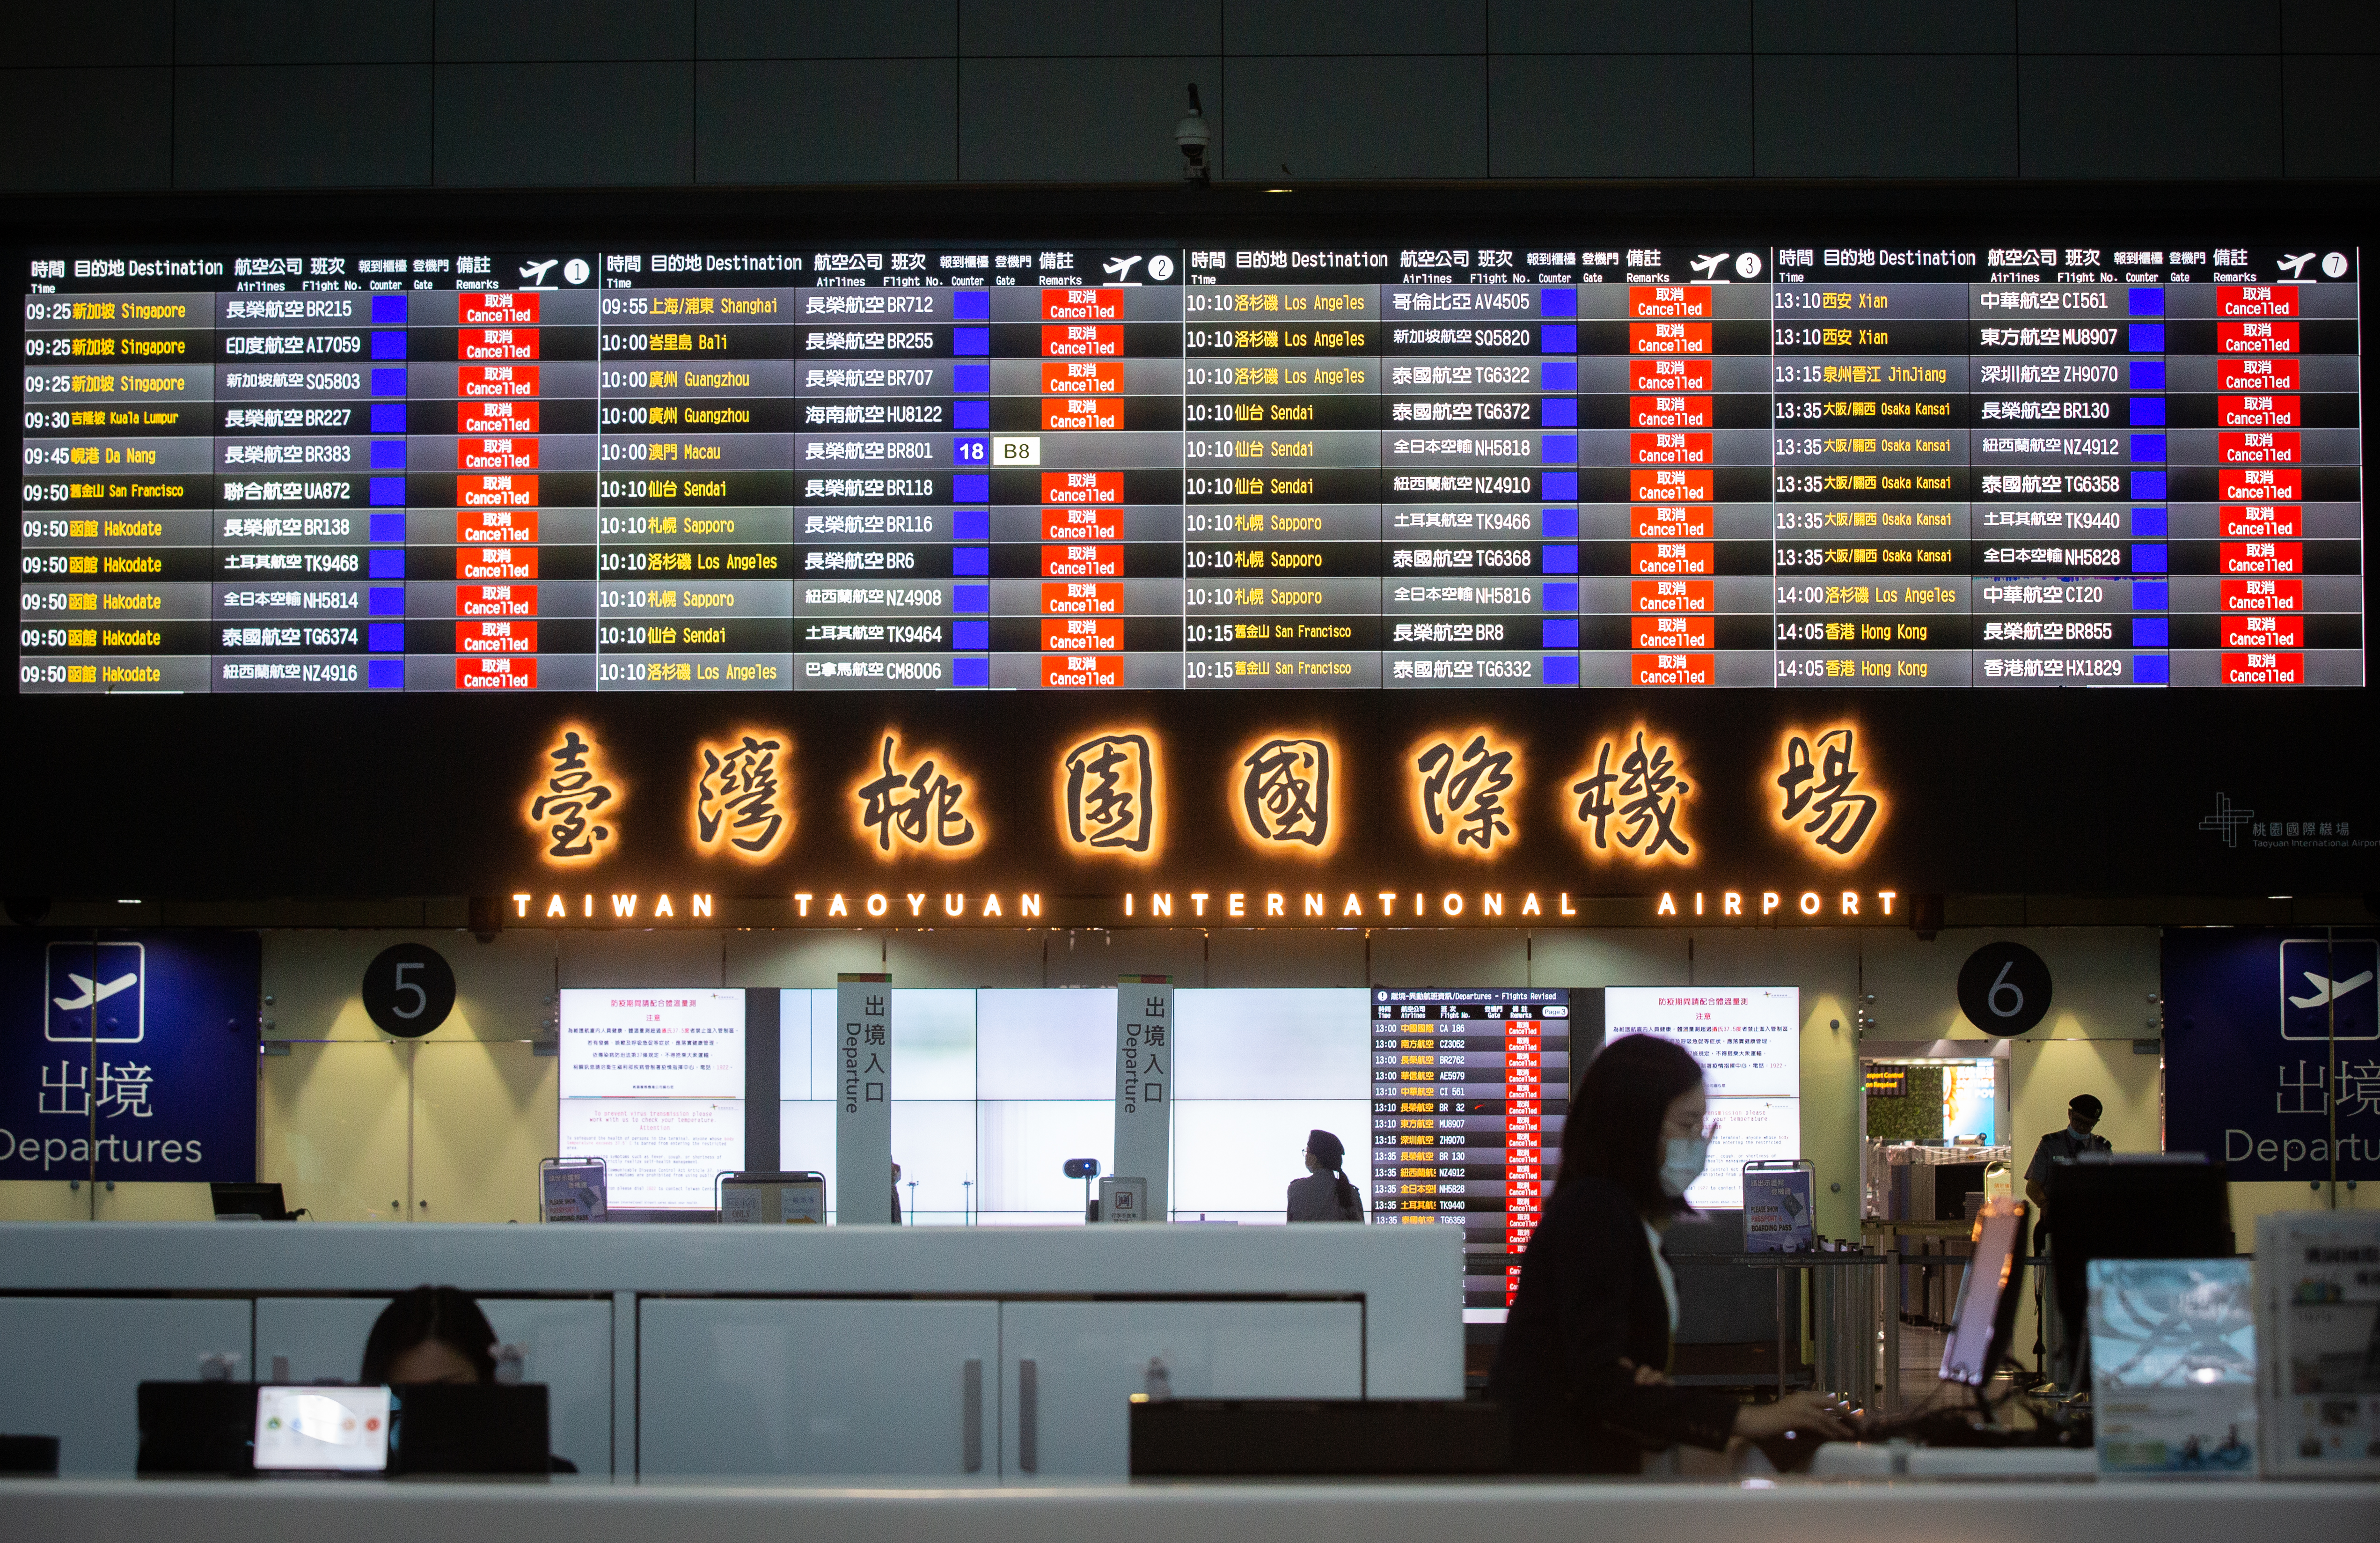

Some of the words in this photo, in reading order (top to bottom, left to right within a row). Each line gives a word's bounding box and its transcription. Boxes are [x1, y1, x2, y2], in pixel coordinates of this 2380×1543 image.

[31, 260, 65, 279] 時間
[75, 259, 125, 277] 目的地
[129, 259, 223, 276] Destination
[234, 257, 302, 276] 航空公司
[310, 257, 345, 275] 班次
[412, 259, 449, 272] 登機門
[456, 256, 491, 274] 備註
[574, 263, 581, 280] 1
[31, 284, 56, 294] Time
[236, 281, 286, 292] Airlines
[302, 280, 339, 292] Flight
[344, 280, 362, 291] No.
[369, 280, 402, 291] Counter
[413, 279, 433, 290] Gate
[456, 279, 499, 290] Remarks
[1655, 287, 1684, 301] 取消
[484, 293, 513, 308] 取消
[1068, 289, 1096, 304] 取消
[1187, 294, 1233, 311] 10:10
[1234, 294, 1278, 311] 洛杉磯
[1285, 294, 1307, 310] Los
[1314, 294, 1364, 311] Angeles
[1392, 293, 1472, 311] 哥倫比亞
[1475, 293, 1530, 309] AV4505
[26, 303, 71, 320] 09:25
[73, 302, 115, 320] 新加坡
[121, 303, 186, 320] Singapore
[226, 300, 304, 319] 長榮航空
[307, 300, 352, 317] BR215
[602, 298, 648, 315] 09:55
[649, 297, 714, 315] 上海/浦東
[721, 298, 777, 315] Shanghai
[806, 295, 885, 314] 長榮航空
[887, 296, 933, 313] BR712
[1050, 305, 1114, 318] Cancelled
[1638, 302, 1702, 316] Cancelled
[467, 309, 530, 322] Cancelled
[601, 443, 647, 460] 10:00
[648, 443, 677, 461] 澳門
[684, 444, 720, 459] Macau
[805, 441, 885, 460] 長榮航空
[887, 442, 933, 459] BR801
[959, 443, 984, 460] 18
[1004, 444, 1029, 459] B8
[1778, 660, 1824, 676] 14:05
[1825, 659, 1855, 676] 香港
[1861, 661, 1891, 677] Hong
[1898, 660, 1928, 677] Kong
[1984, 658, 2064, 677] 香港航空
[2066, 660, 2122, 676] HX1829
[2248, 654, 2276, 668] 取消
[2230, 669, 2294, 682] Cancelled
[2253, 822, 2349, 836] 桃園國際機場
[2253, 840, 2289, 848] Taoyuan
[513, 894, 711, 917] TAIWAN
[795, 894, 1040, 916] TAOYUAN
[1126, 893, 1575, 916] INTERNATIONAL
[1657, 892, 1896, 915] AIRPORT
[392, 963, 426, 1019] 5
[1501, 992, 1528, 1001] Flights
[1988, 961, 2024, 1018] 6
[1376, 1024, 1397, 1033] 13:00
[1401, 1024, 1434, 1033] 中國國際
[1439, 1024, 1449, 1033] CA
[1452, 1024, 1465, 1033] 186
[864, 995, 886, 1102] 出境入口
[1144, 996, 1165, 1103] 出境入口
[1376, 1040, 1397, 1049] 13:00
[1401, 1039, 1434, 1049] 南方航空
[1439, 1040, 1465, 1049] CZ3052
[843, 1022, 861, 1113] Departure
[1122, 1024, 1142, 1113] Departure
[1376, 1072, 1397, 1080] 13:00
[1401, 1071, 1434, 1080] 華信航空
[1440, 1071, 1465, 1080] AE5979
[39, 1060, 154, 1118] 出境
[2277, 1059, 2380, 1117] 出境
